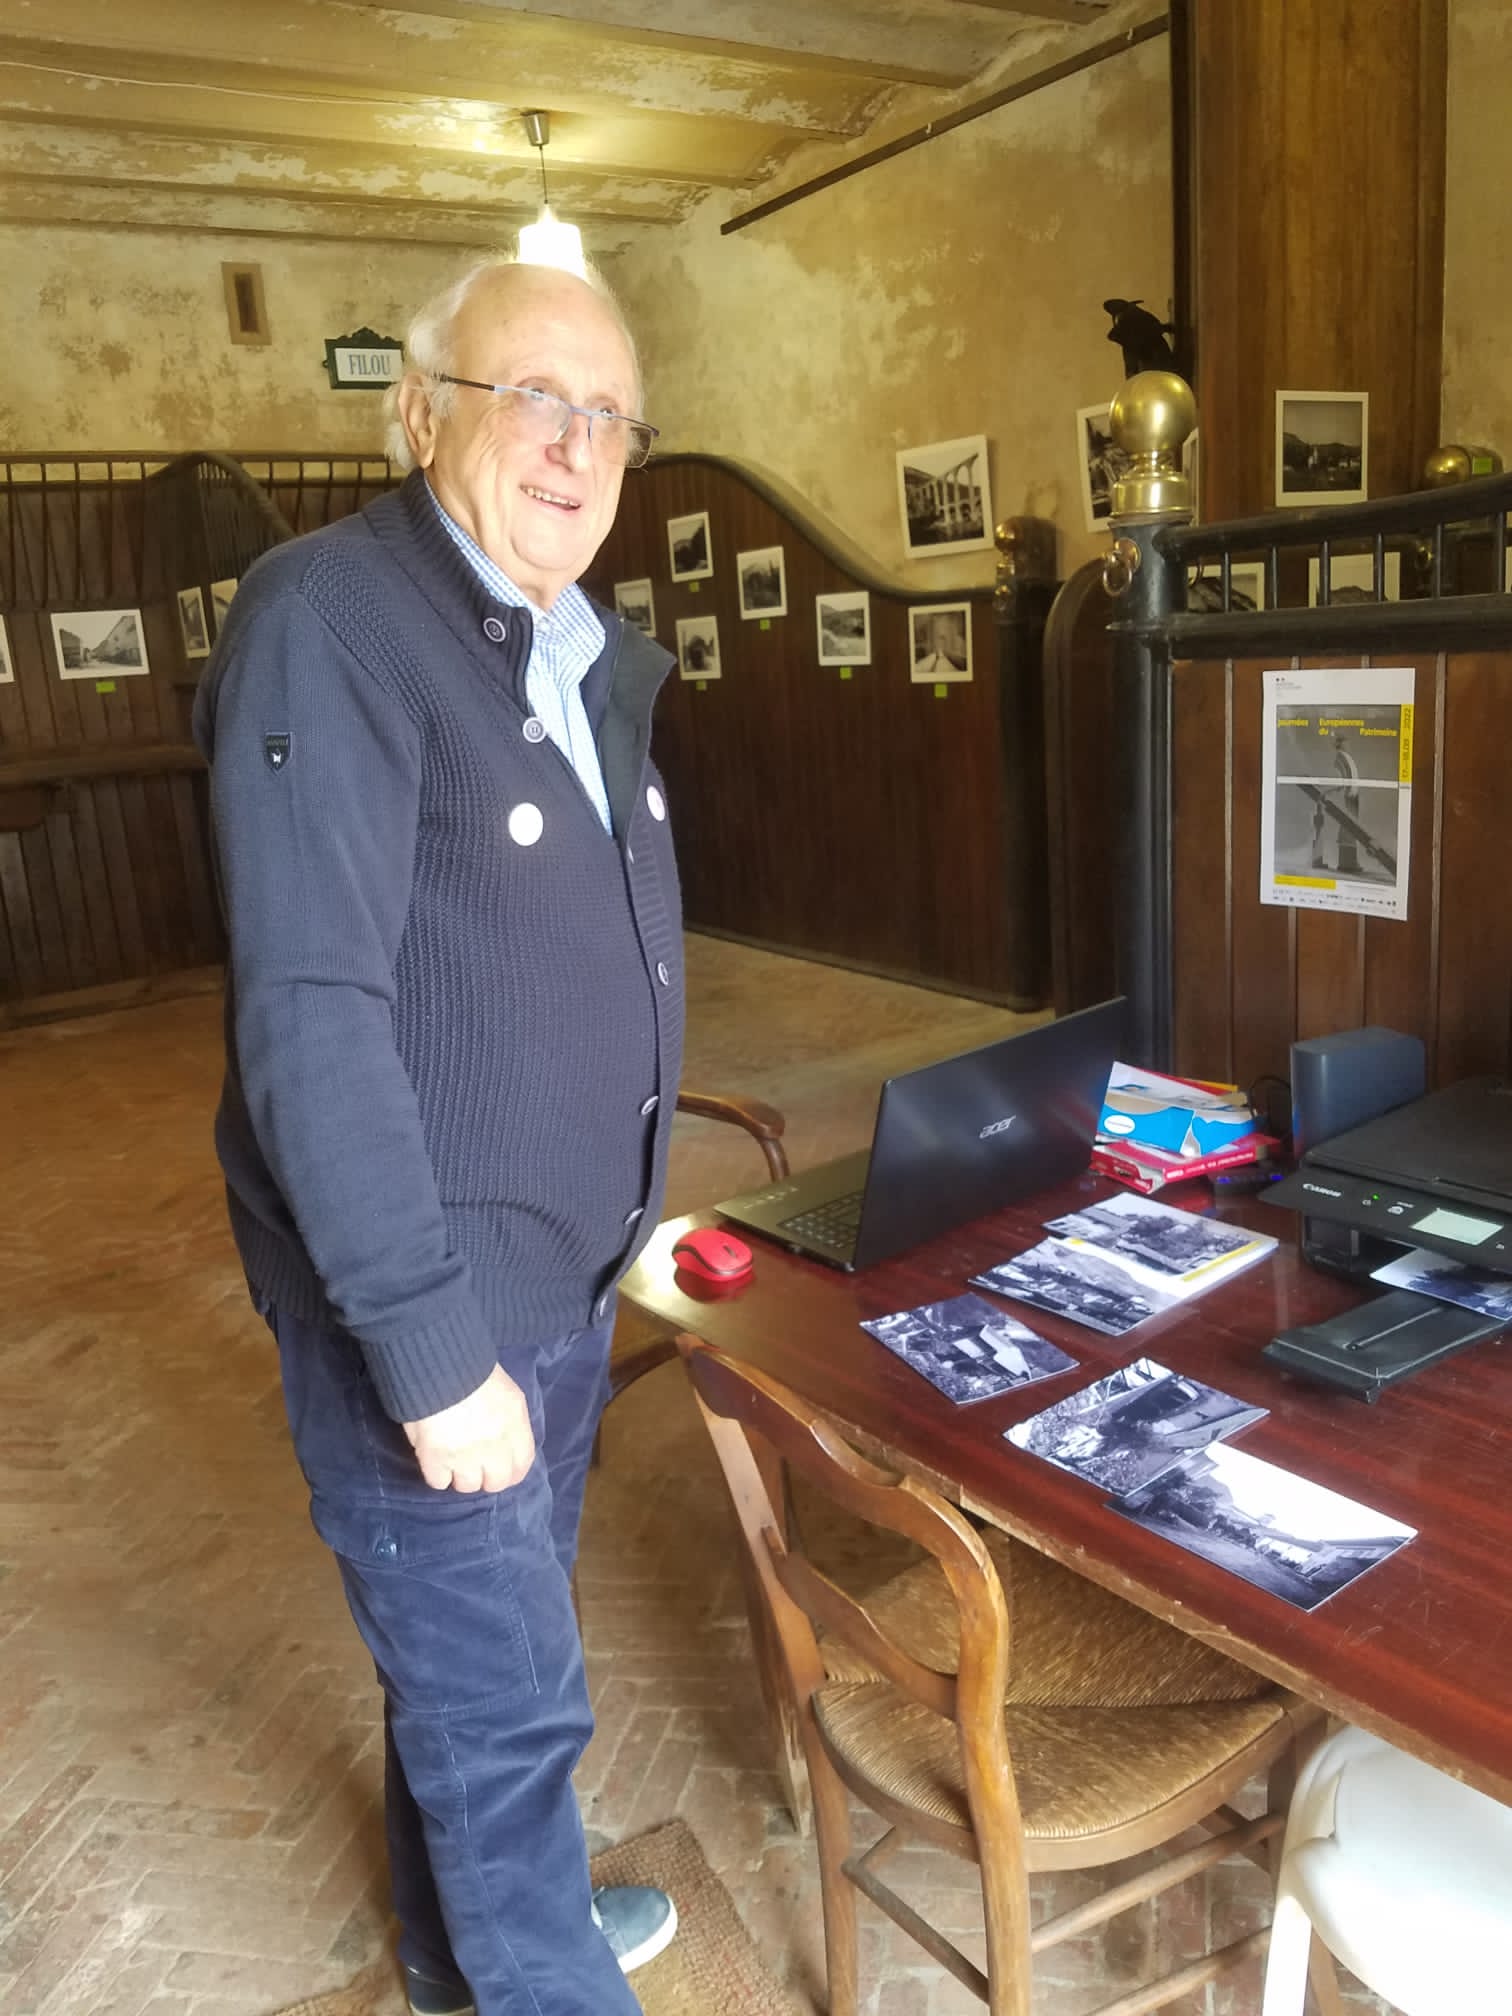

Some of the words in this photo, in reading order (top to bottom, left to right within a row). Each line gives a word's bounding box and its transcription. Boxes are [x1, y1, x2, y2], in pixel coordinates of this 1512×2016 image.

[348, 353, 391, 376] FILOU
[979, 1115, 1017, 1138] acer
[1302, 1183, 1342, 1197] Canon
